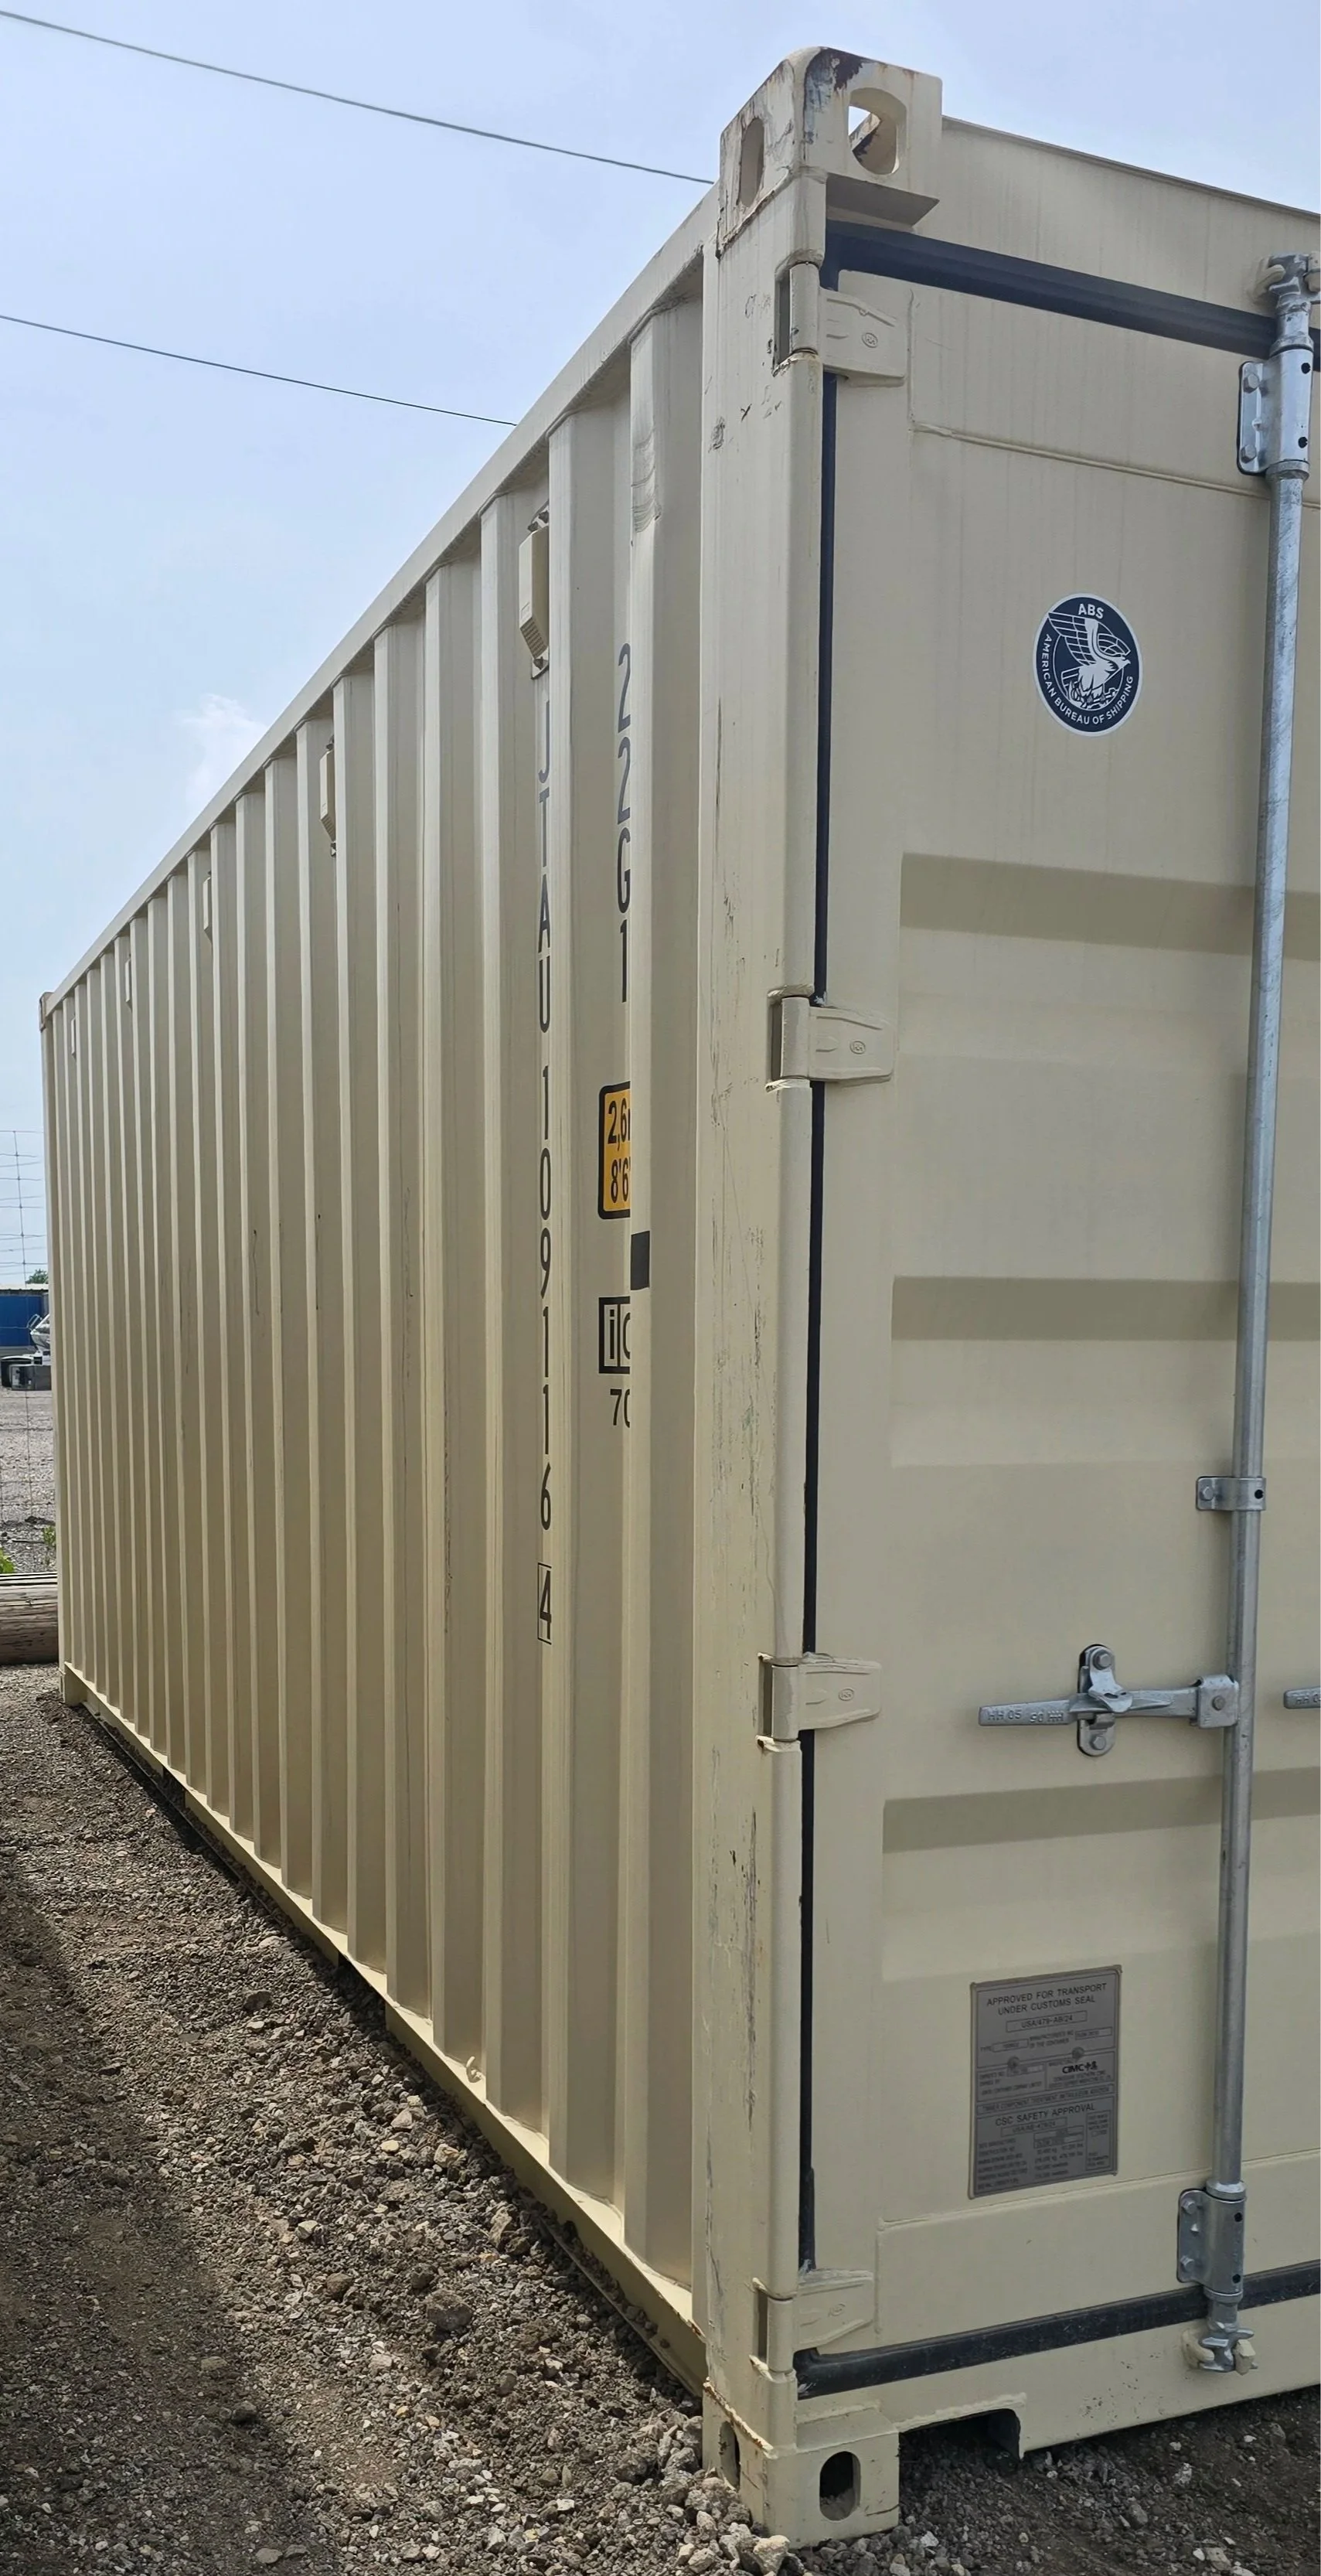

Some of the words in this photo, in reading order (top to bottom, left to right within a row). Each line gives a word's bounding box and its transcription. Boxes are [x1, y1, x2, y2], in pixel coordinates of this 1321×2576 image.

[1078, 603, 1105, 619] ABS
[1041, 633, 1057, 697] AMERICAN
[1054, 697, 1090, 725] BUREAU
[1091, 714, 1105, 725] OF
[1107, 676, 1134, 720] SHIPPING
[618, 643, 631, 1003] 22G1
[538, 700, 550, 1033] JTAU
[608, 1098, 631, 1151] 2,6
[540, 1065, 551, 1531] 109116
[540, 1571, 551, 1640] 4
[986, 1992, 1033, 2007] APPROVED
[1036, 1989, 1054, 1999] FOR
[1057, 1982, 1107, 1996] TRANSPORT
[998, 2005, 1028, 2015] UNDER
[1030, 1998, 1071, 2012] CUSTOMS
[1074, 1995, 1095, 2005] SEAL
[995, 2116, 1014, 2127] CSC
[1016, 2110, 1049, 2123] SAFETY
[1052, 2102, 1095, 2117] APPROVAL
